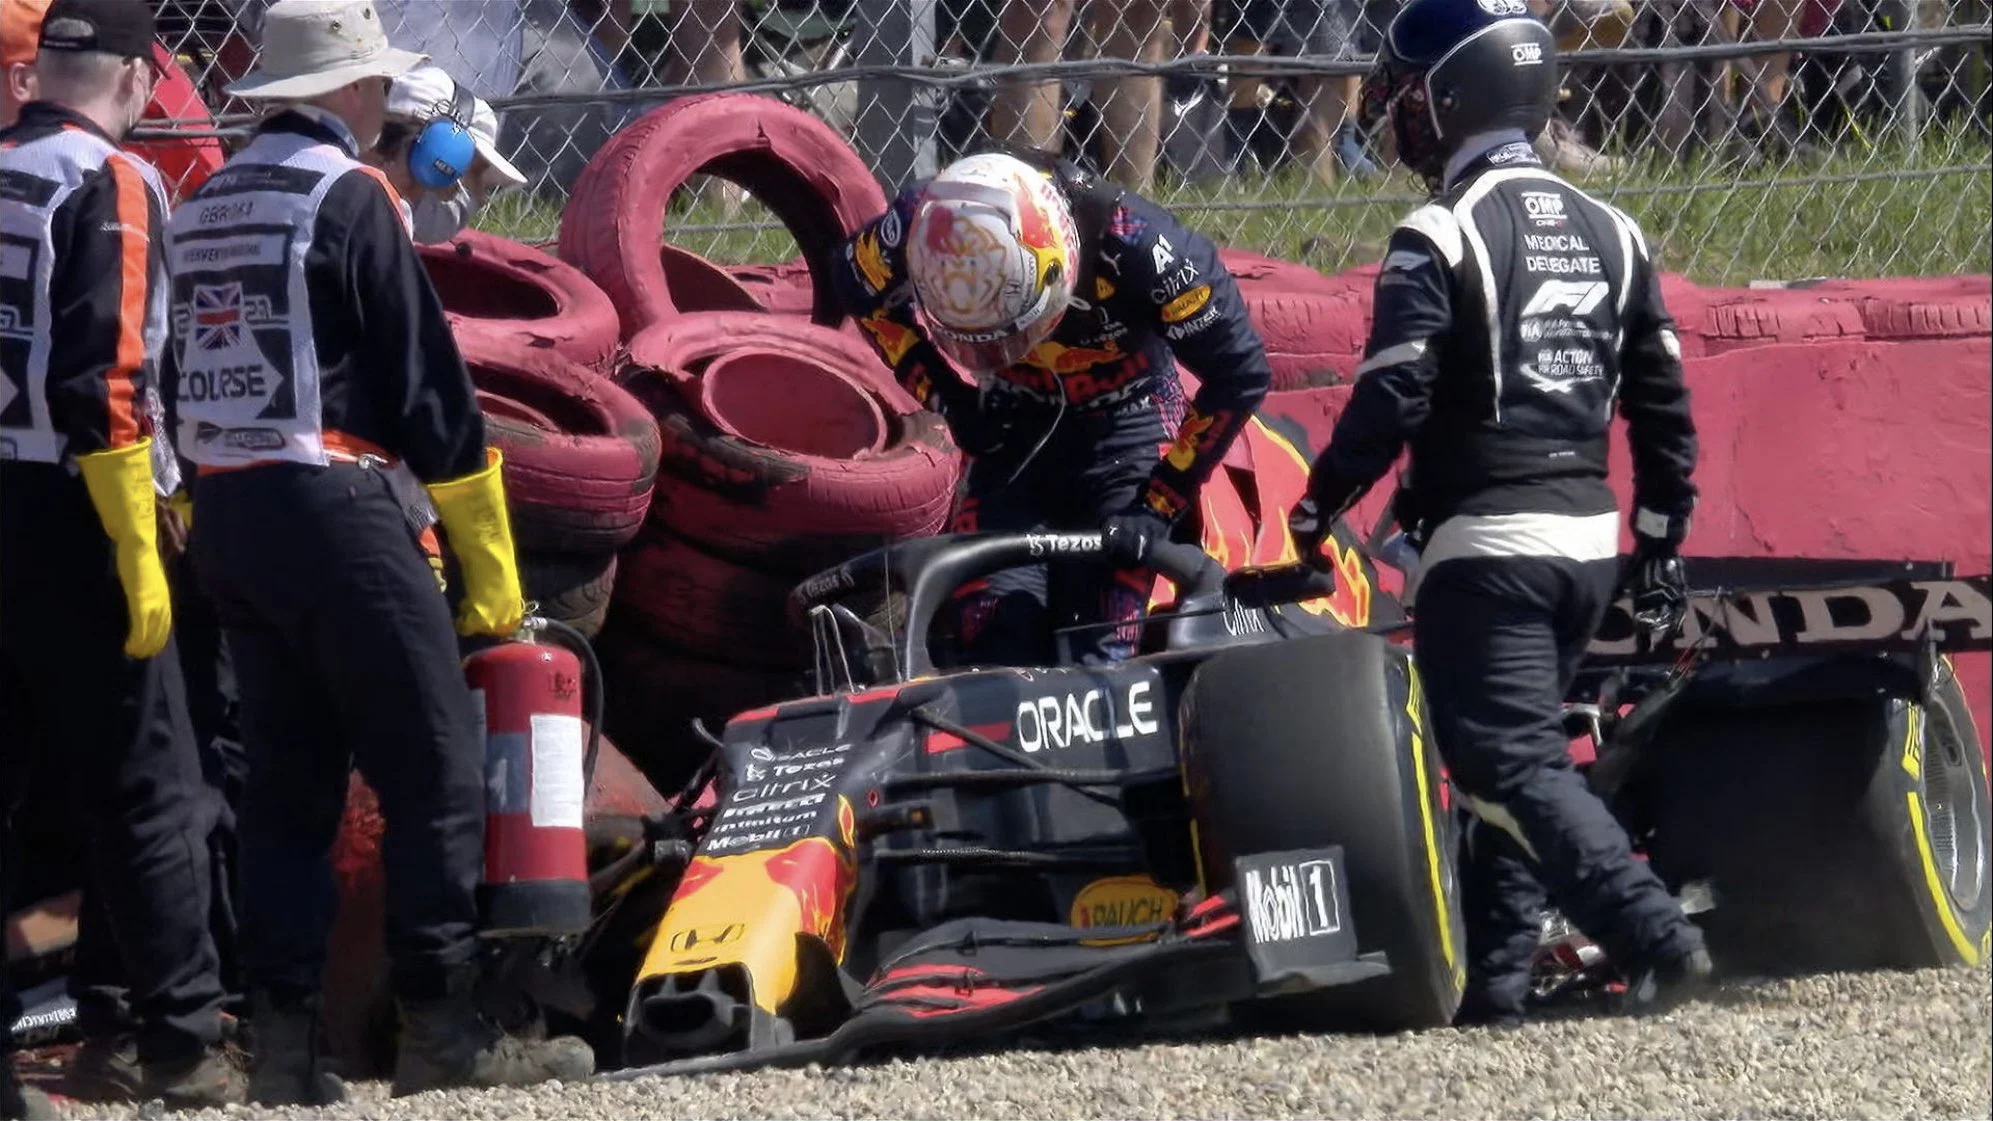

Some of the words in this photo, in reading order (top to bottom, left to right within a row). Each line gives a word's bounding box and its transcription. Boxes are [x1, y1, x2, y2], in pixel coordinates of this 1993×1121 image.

[1512, 46, 1542, 62] OMP
[1524, 196, 1565, 215] OMP
[1523, 234, 1590, 252] MEDICAL
[1525, 255, 1601, 275] DELEGATE
[1045, 533, 1103, 552] Tezos
[1016, 680, 1158, 753] ORACLE
[1245, 865, 1305, 944] Mobil
